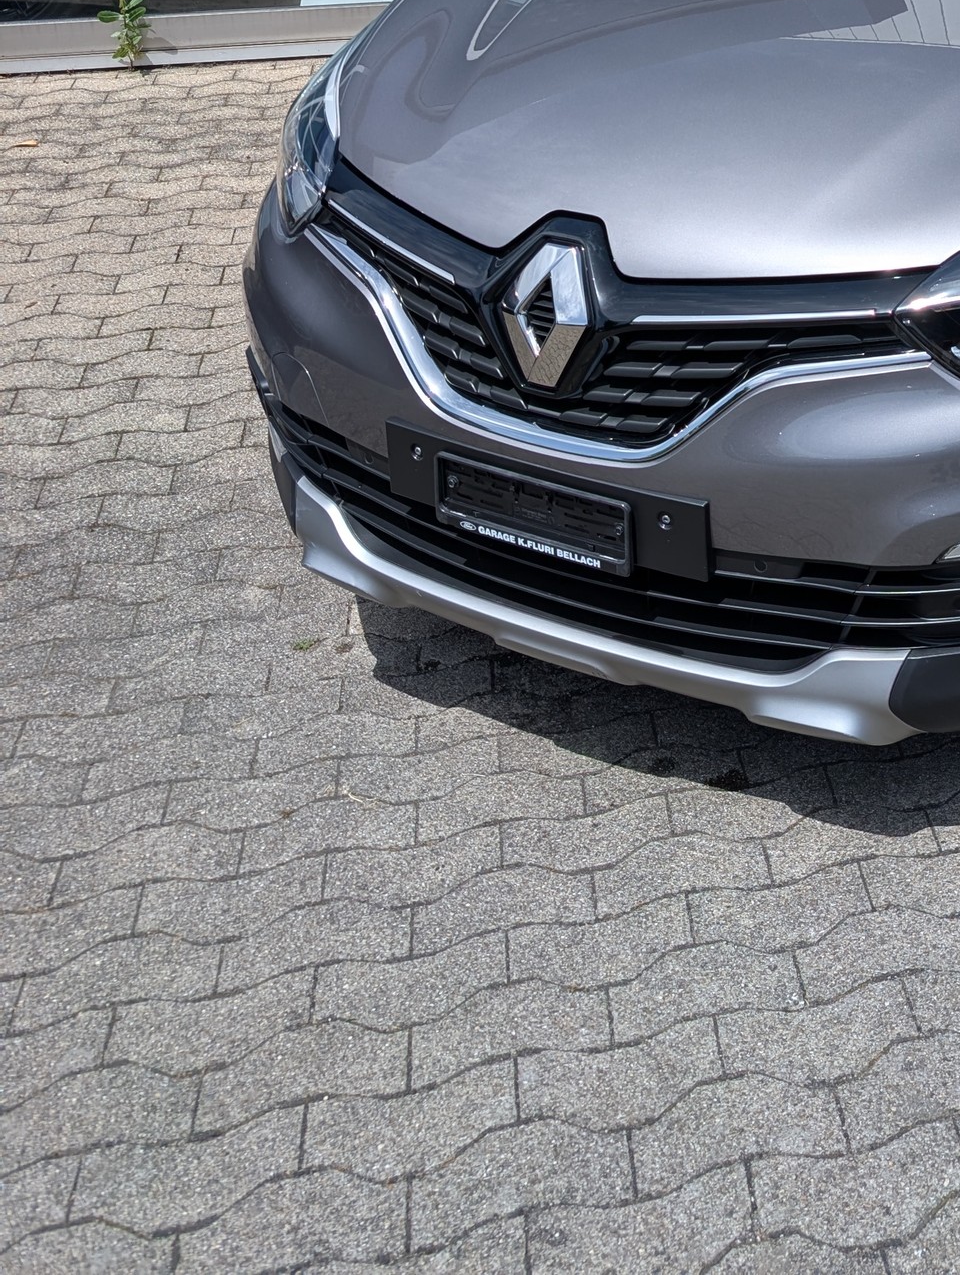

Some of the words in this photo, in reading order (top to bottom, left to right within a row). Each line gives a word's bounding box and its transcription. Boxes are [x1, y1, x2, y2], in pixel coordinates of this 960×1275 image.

[478, 526, 516, 544] GARAGE
[517, 537, 555, 556] K.FLURI
[556, 548, 601, 569] BELLACH
